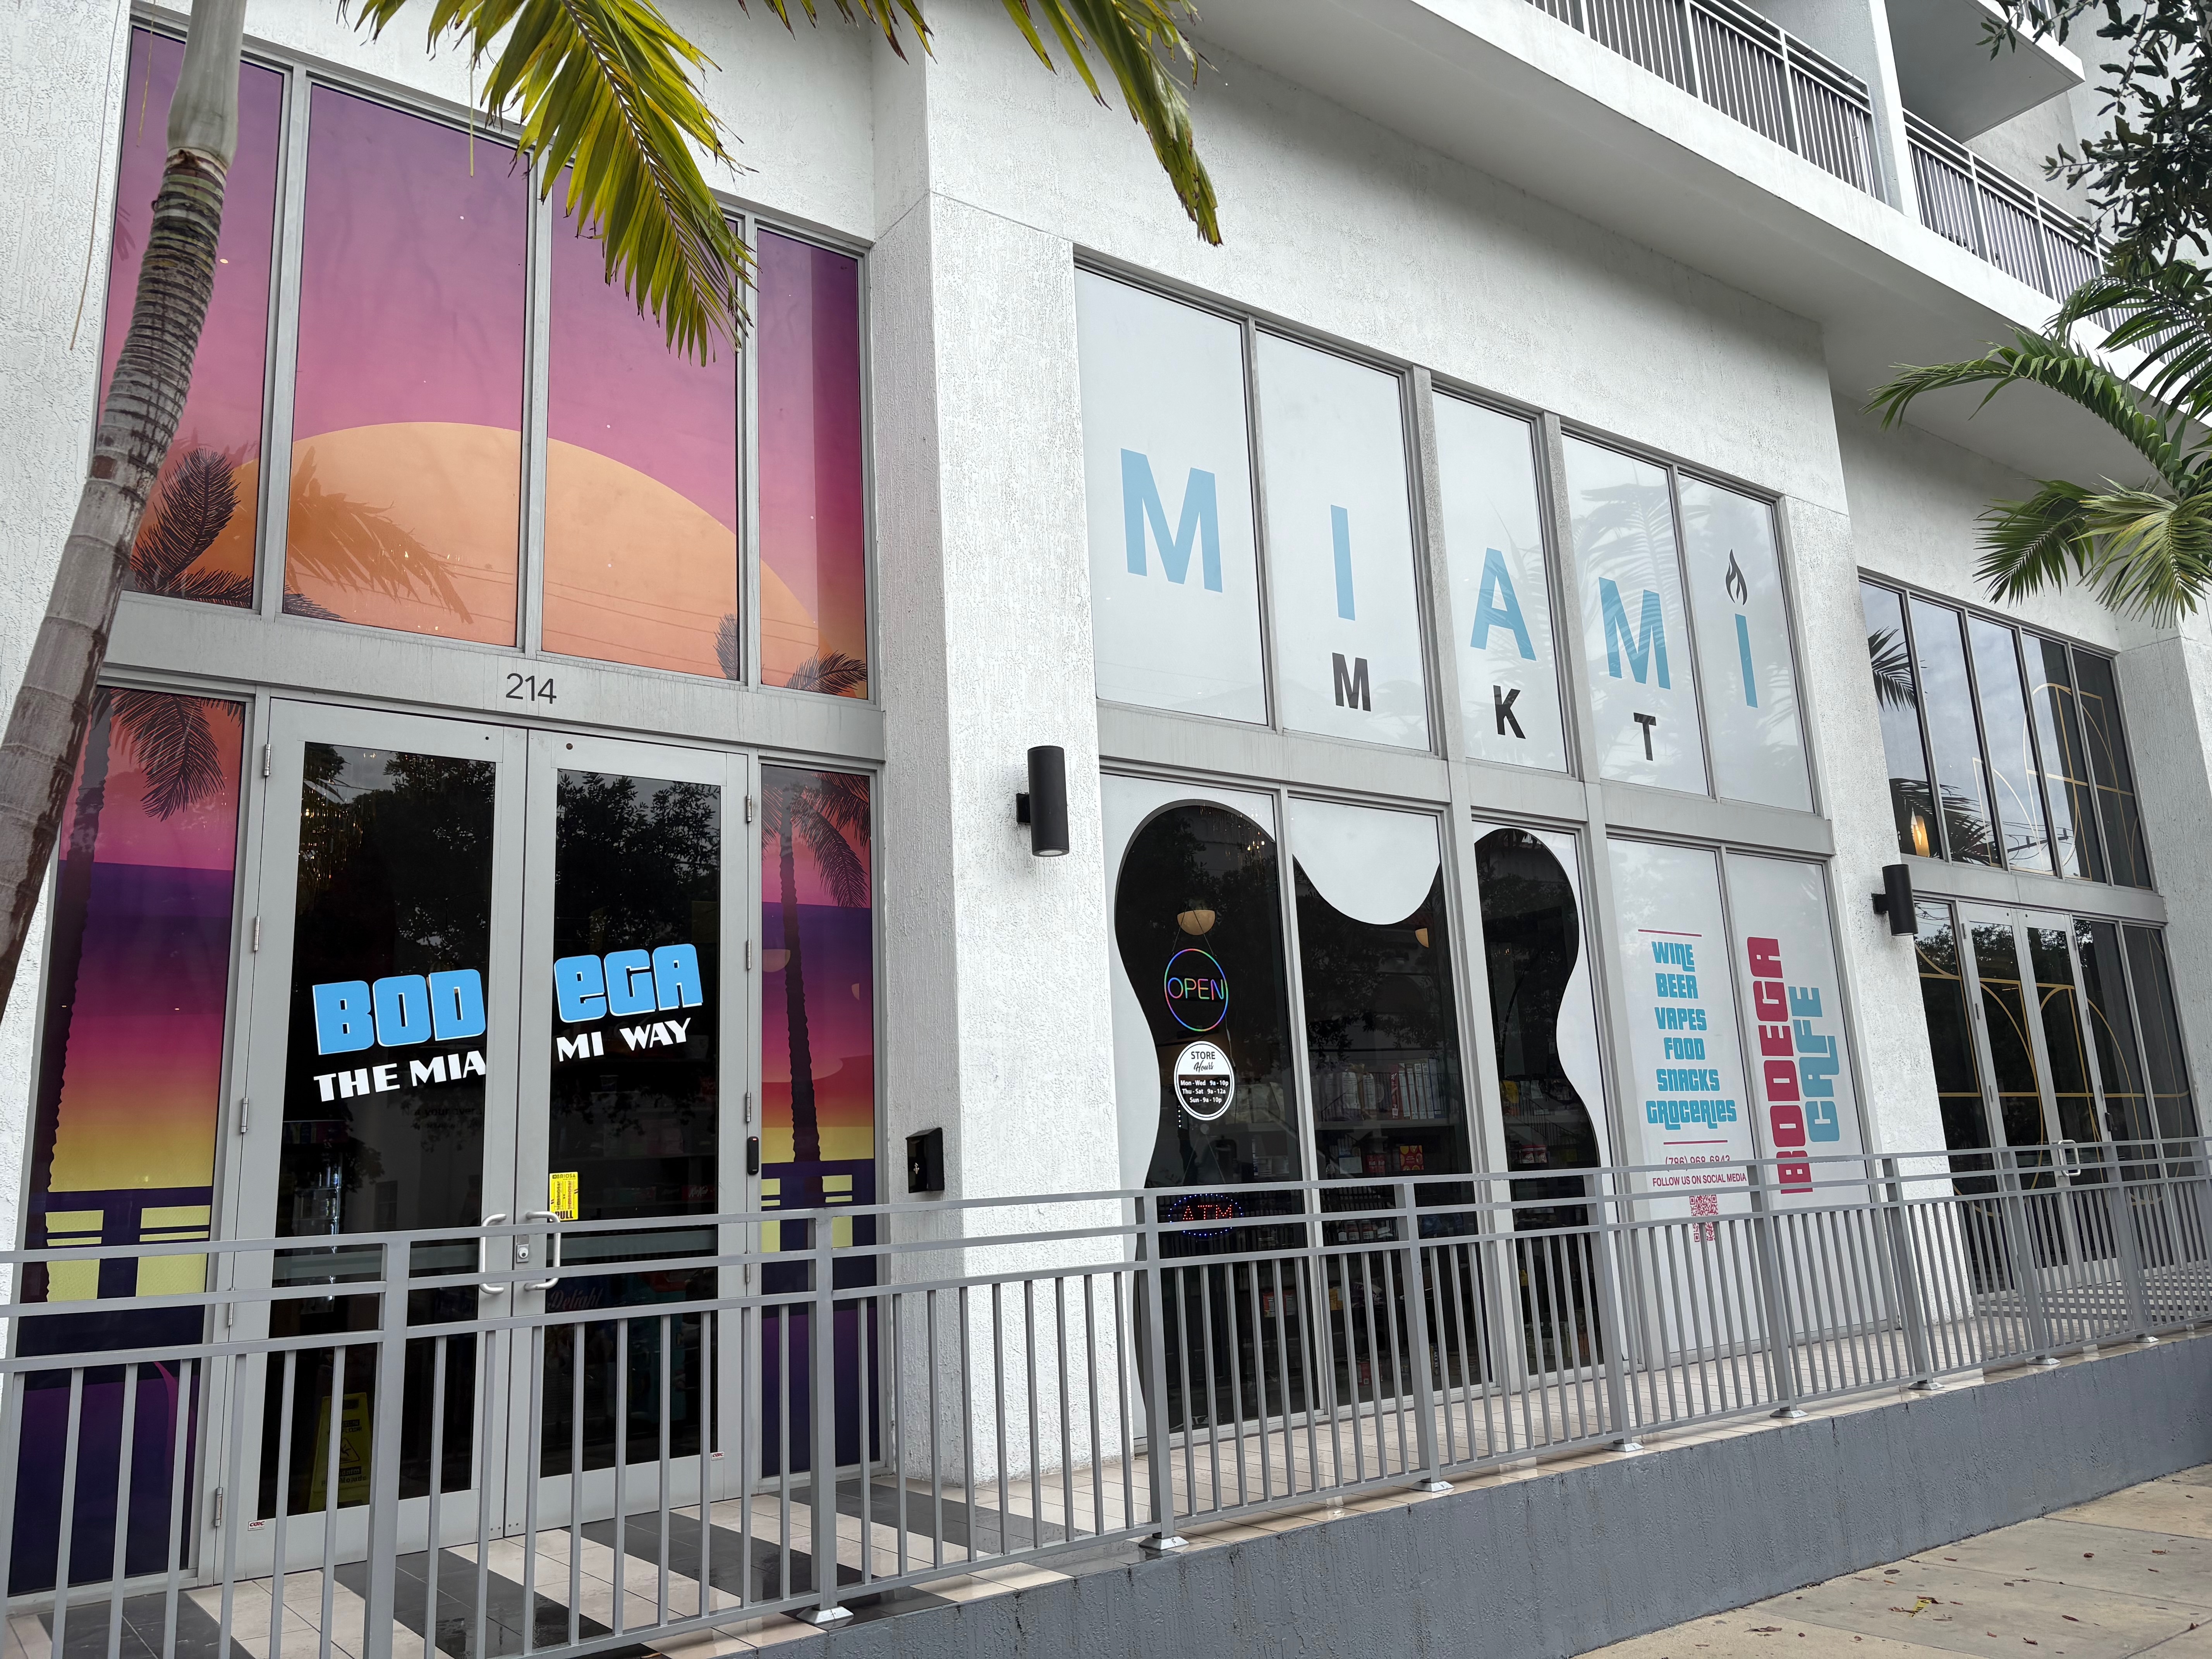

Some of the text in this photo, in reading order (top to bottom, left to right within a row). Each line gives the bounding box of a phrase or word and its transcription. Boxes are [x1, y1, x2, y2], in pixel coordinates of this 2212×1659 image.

[1121, 448, 1758, 708] MIAMI
[506, 673, 556, 704] 214
[1167, 977, 1224, 1000] OPEN
[1655, 973, 1698, 999] BEER
[1654, 1007, 1707, 1031] VAPES
[313, 1063, 400, 1102] THE
[556, 1032, 604, 1062] MI
[619, 1018, 691, 1051] WAY
[1191, 1051, 1216, 1060] STORE
[1664, 1037, 1705, 1060] FOOD
[1194, 1060, 1214, 1073] Hours
[1747, 936, 1813, 1194] BODEGA
[1789, 986, 1840, 1142] CAFE
[1652, 1173, 1747, 1187] FOLLOW US ON SOCIAL MEDIA
[555, 1210, 574, 1219] PULL
[1182, 1204, 1232, 1219] ATM
